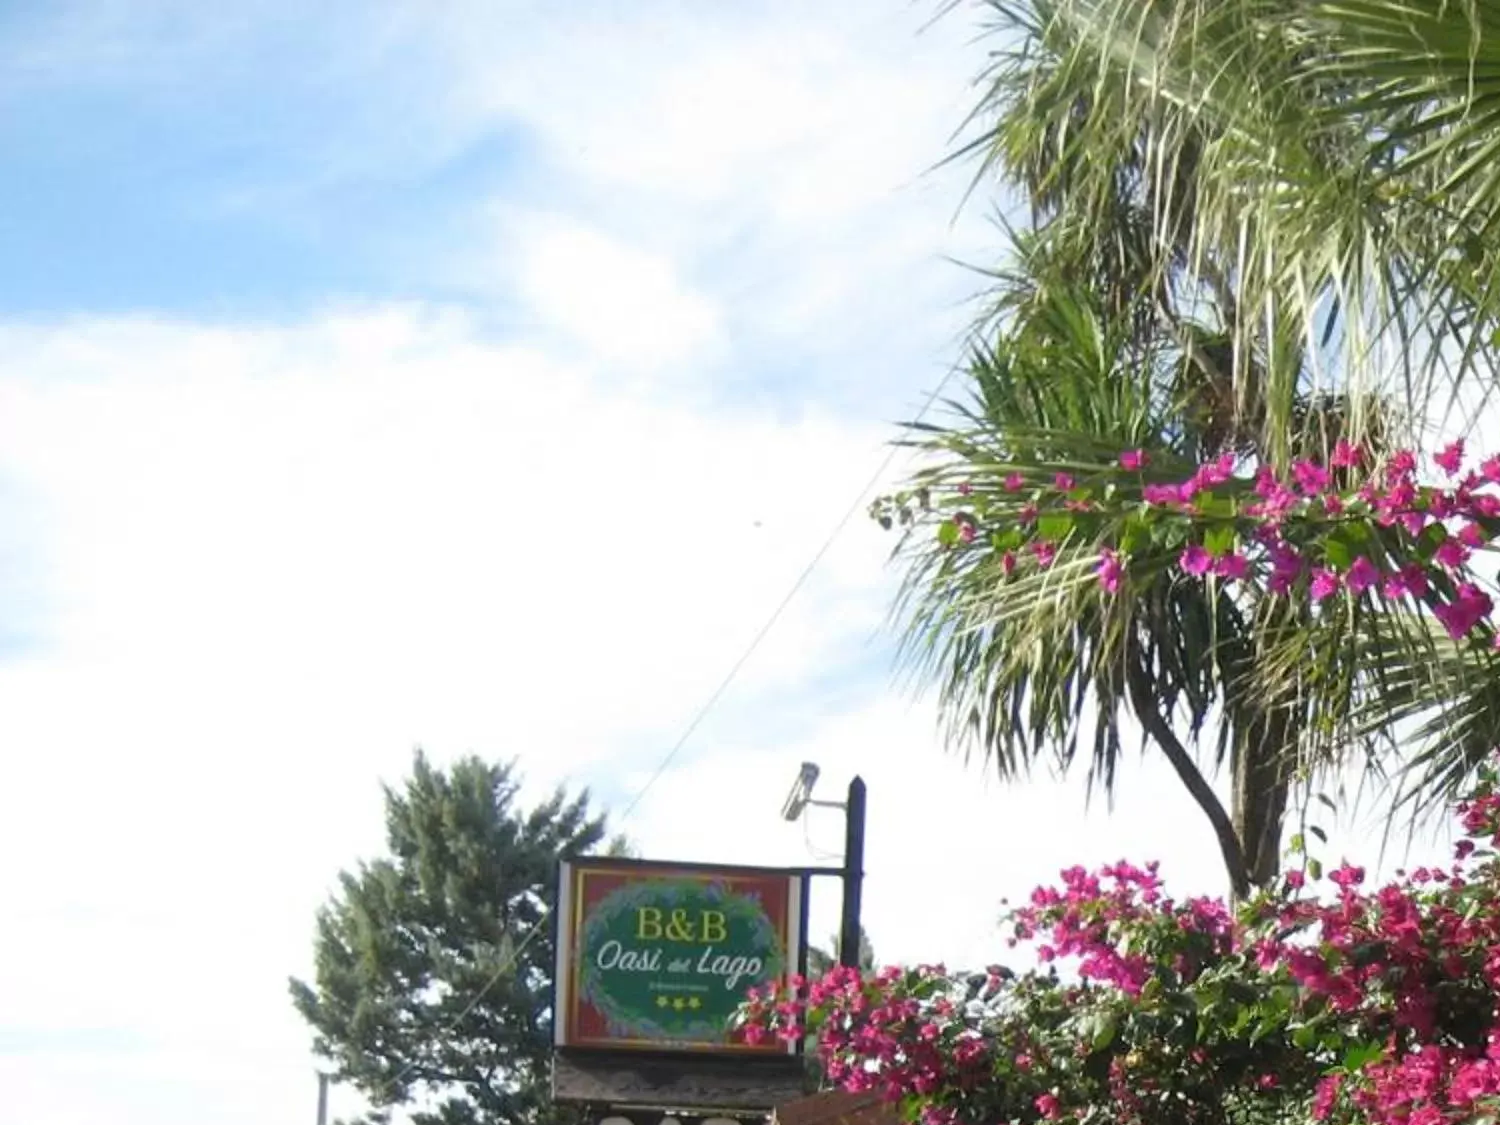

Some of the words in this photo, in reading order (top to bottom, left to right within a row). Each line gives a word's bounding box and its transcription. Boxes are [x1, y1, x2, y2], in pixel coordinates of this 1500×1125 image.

[636, 907, 728, 943] B&B
[597, 940, 661, 971] Oasi
[697, 946, 762, 990] Lago
